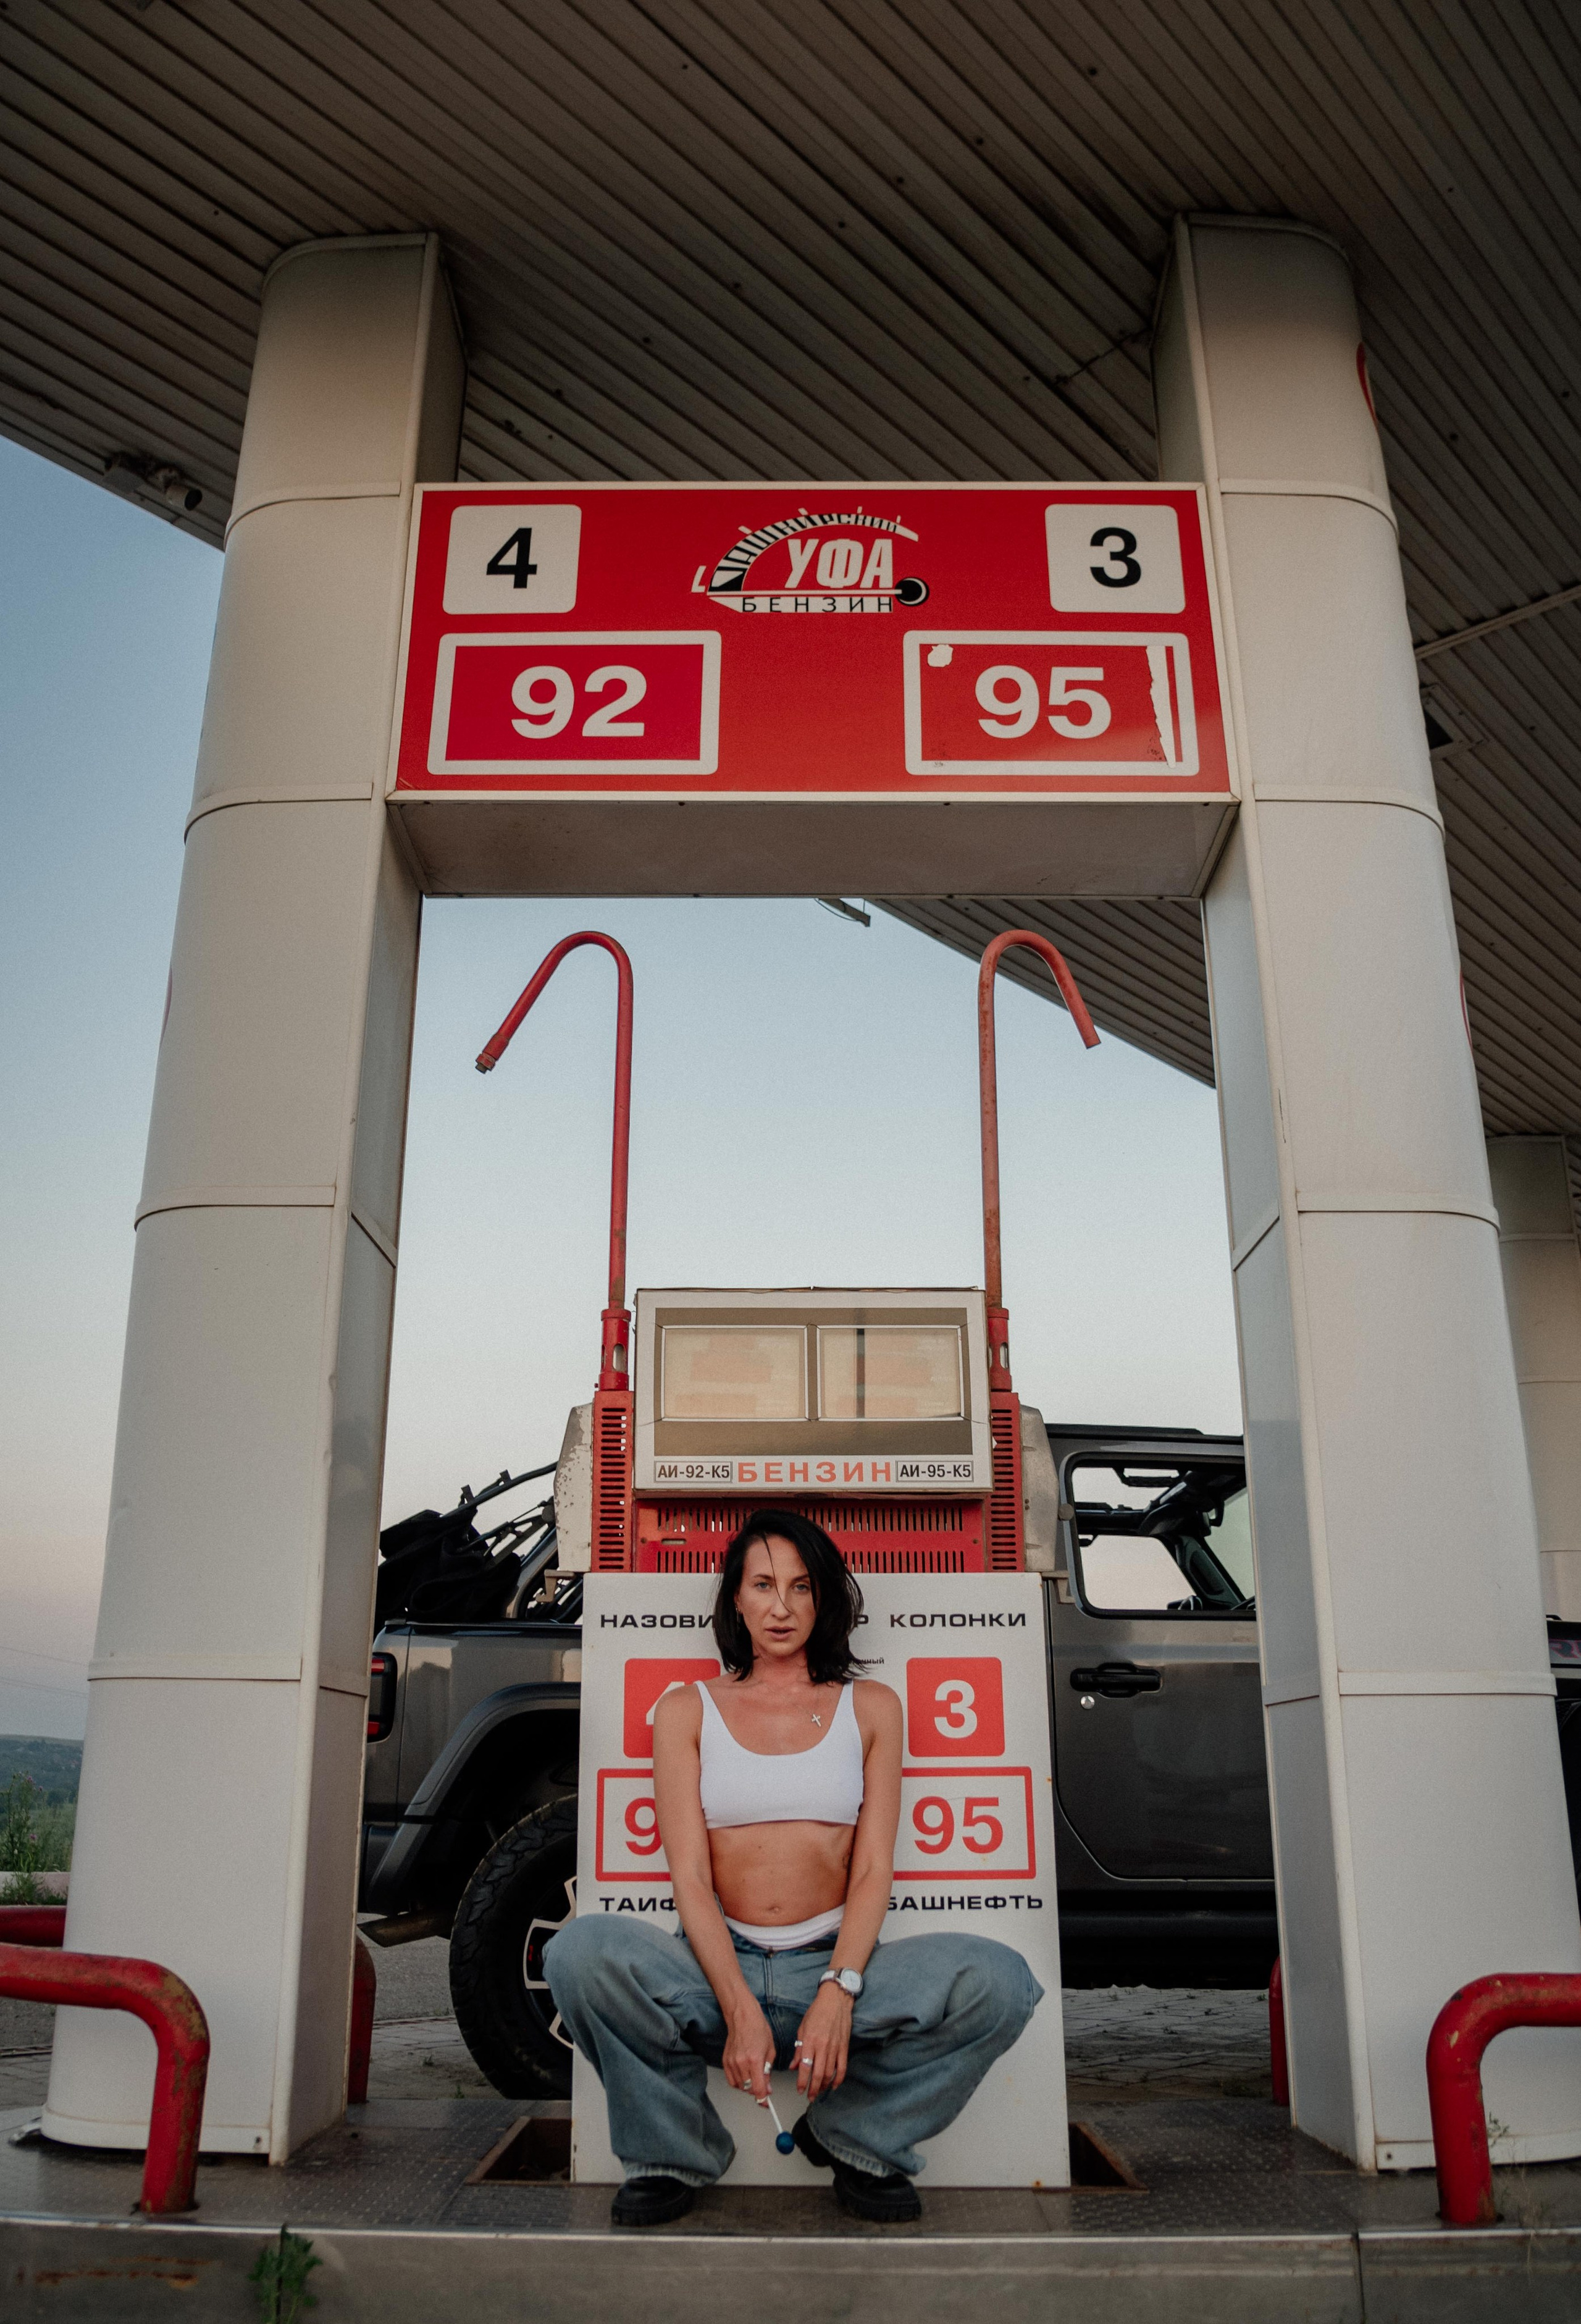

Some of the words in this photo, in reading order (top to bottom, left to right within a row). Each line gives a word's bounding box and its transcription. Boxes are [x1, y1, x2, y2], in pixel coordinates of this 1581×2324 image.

[486, 527, 537, 589] 4
[784, 538, 893, 589] УФА
[1089, 527, 1141, 587] 3
[742, 597, 892, 613] БЕНЗИН
[511, 665, 647, 739] 92
[975, 665, 1112, 739] 95
[657, 1464, 730, 1480] АИ-92-К5
[738, 1462, 892, 1483] БЕНЗИН
[899, 1463, 971, 1479] АИ-95-К5
[890, 1613, 1026, 1628] КОЛОНКИ
[934, 1679, 978, 1739] 3
[912, 1795, 1003, 1855] 95
[887, 1895, 1043, 1911] БАШНЕФТЬ
